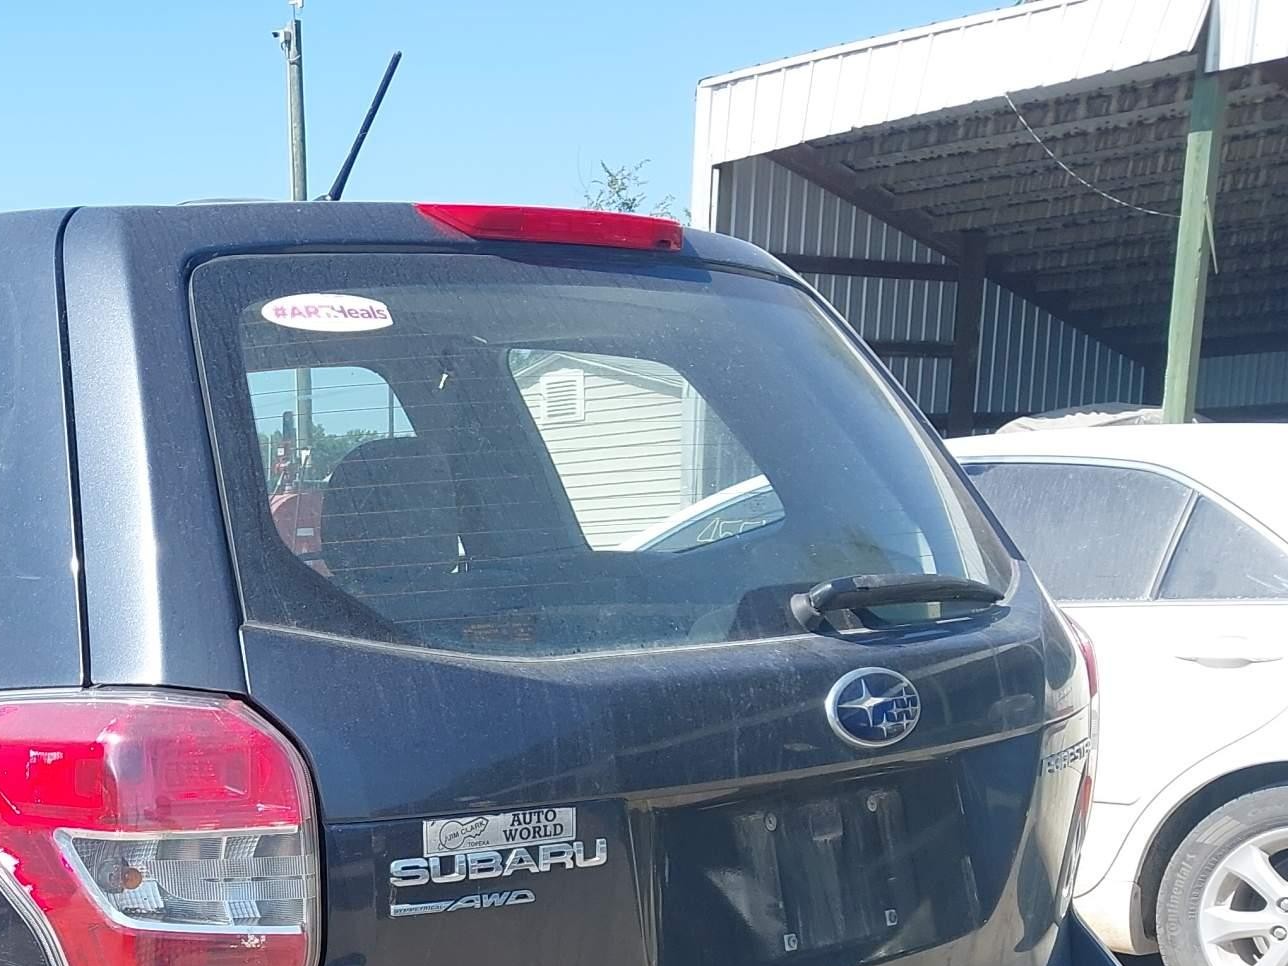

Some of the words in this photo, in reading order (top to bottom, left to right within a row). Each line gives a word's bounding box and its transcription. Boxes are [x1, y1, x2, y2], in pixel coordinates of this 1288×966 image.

[510, 809, 557, 827] AUTO
[447, 831, 460, 841] JIM
[461, 820, 485, 835] CLARK
[503, 823, 563, 843] WORLD
[390, 838, 607, 887] SUBARU
[446, 889, 536, 912] AWD
